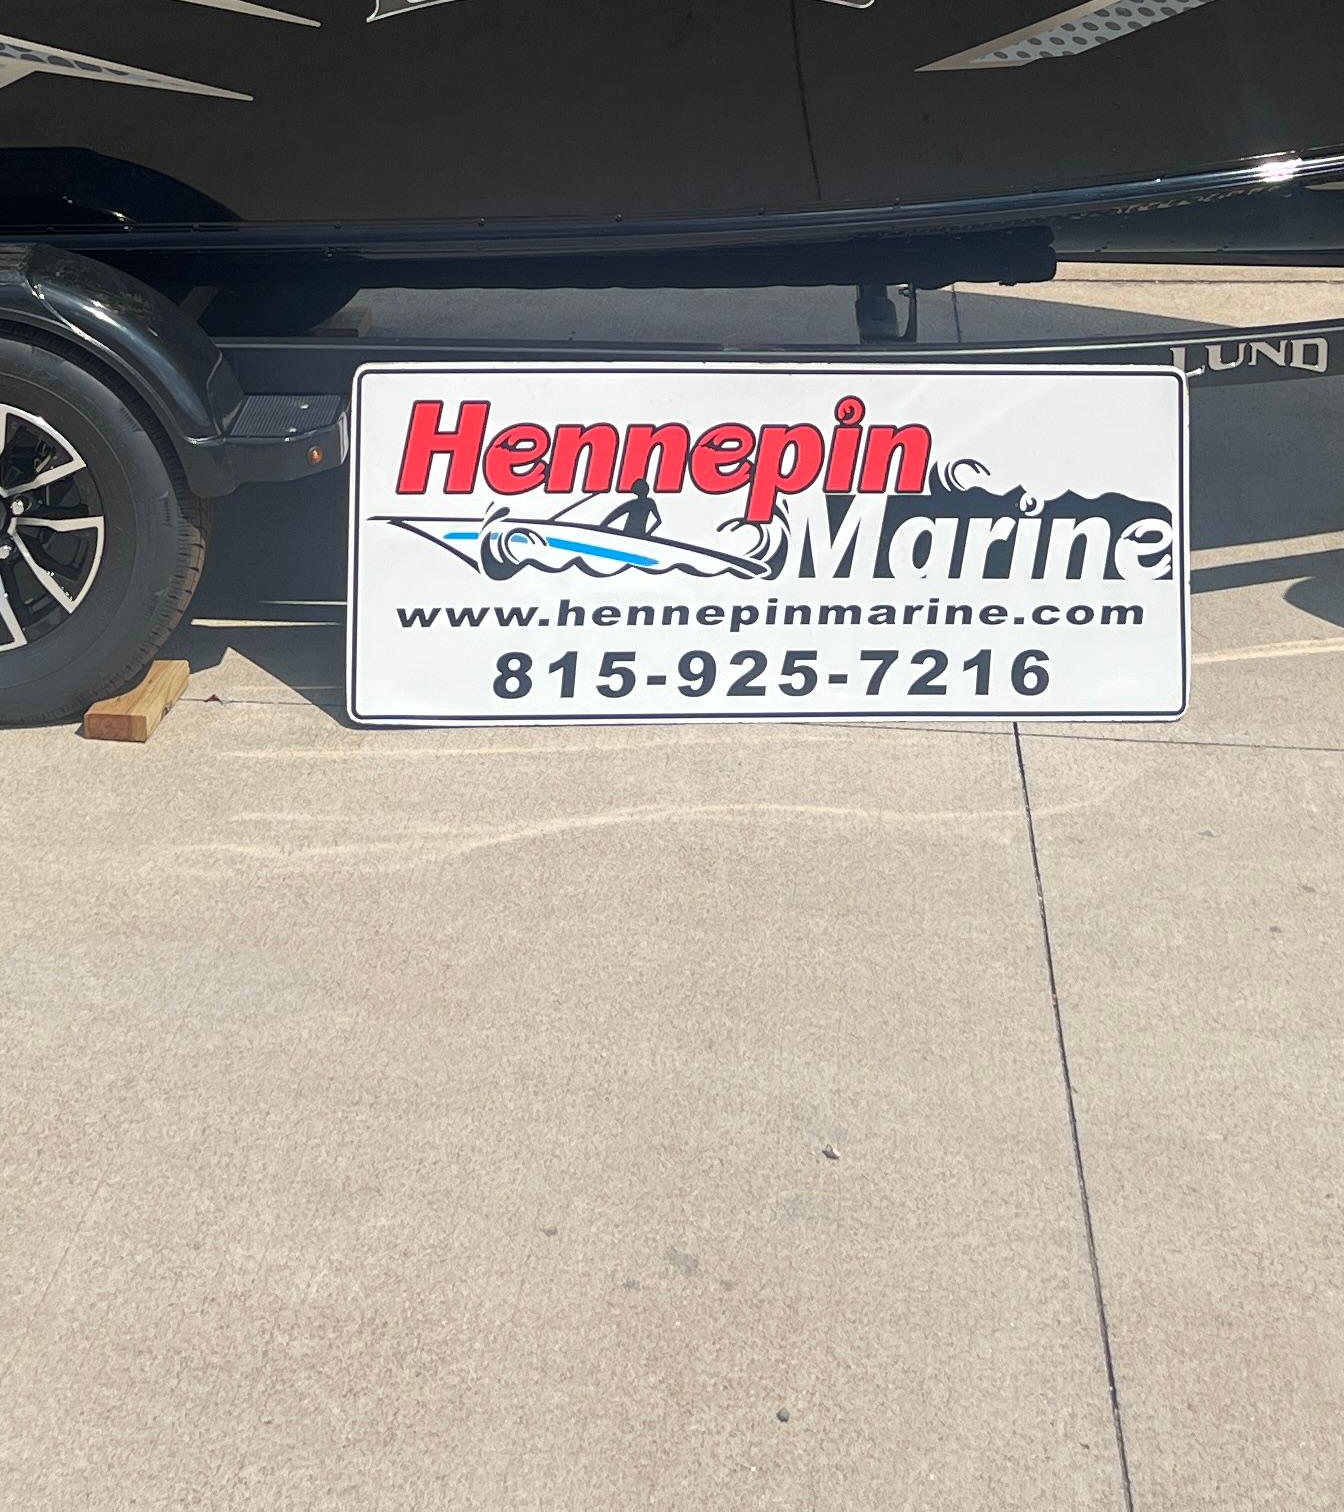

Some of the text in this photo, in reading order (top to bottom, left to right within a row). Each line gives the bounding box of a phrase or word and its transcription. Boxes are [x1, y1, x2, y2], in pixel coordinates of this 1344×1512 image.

[1170, 337, 1329, 377] LUND
[396, 395, 934, 525] Hennepin
[790, 487, 1173, 580] Marine
[397, 598, 1145, 633] www.hennepinmarine.com
[492, 647, 1050, 700] 815-925-7216
